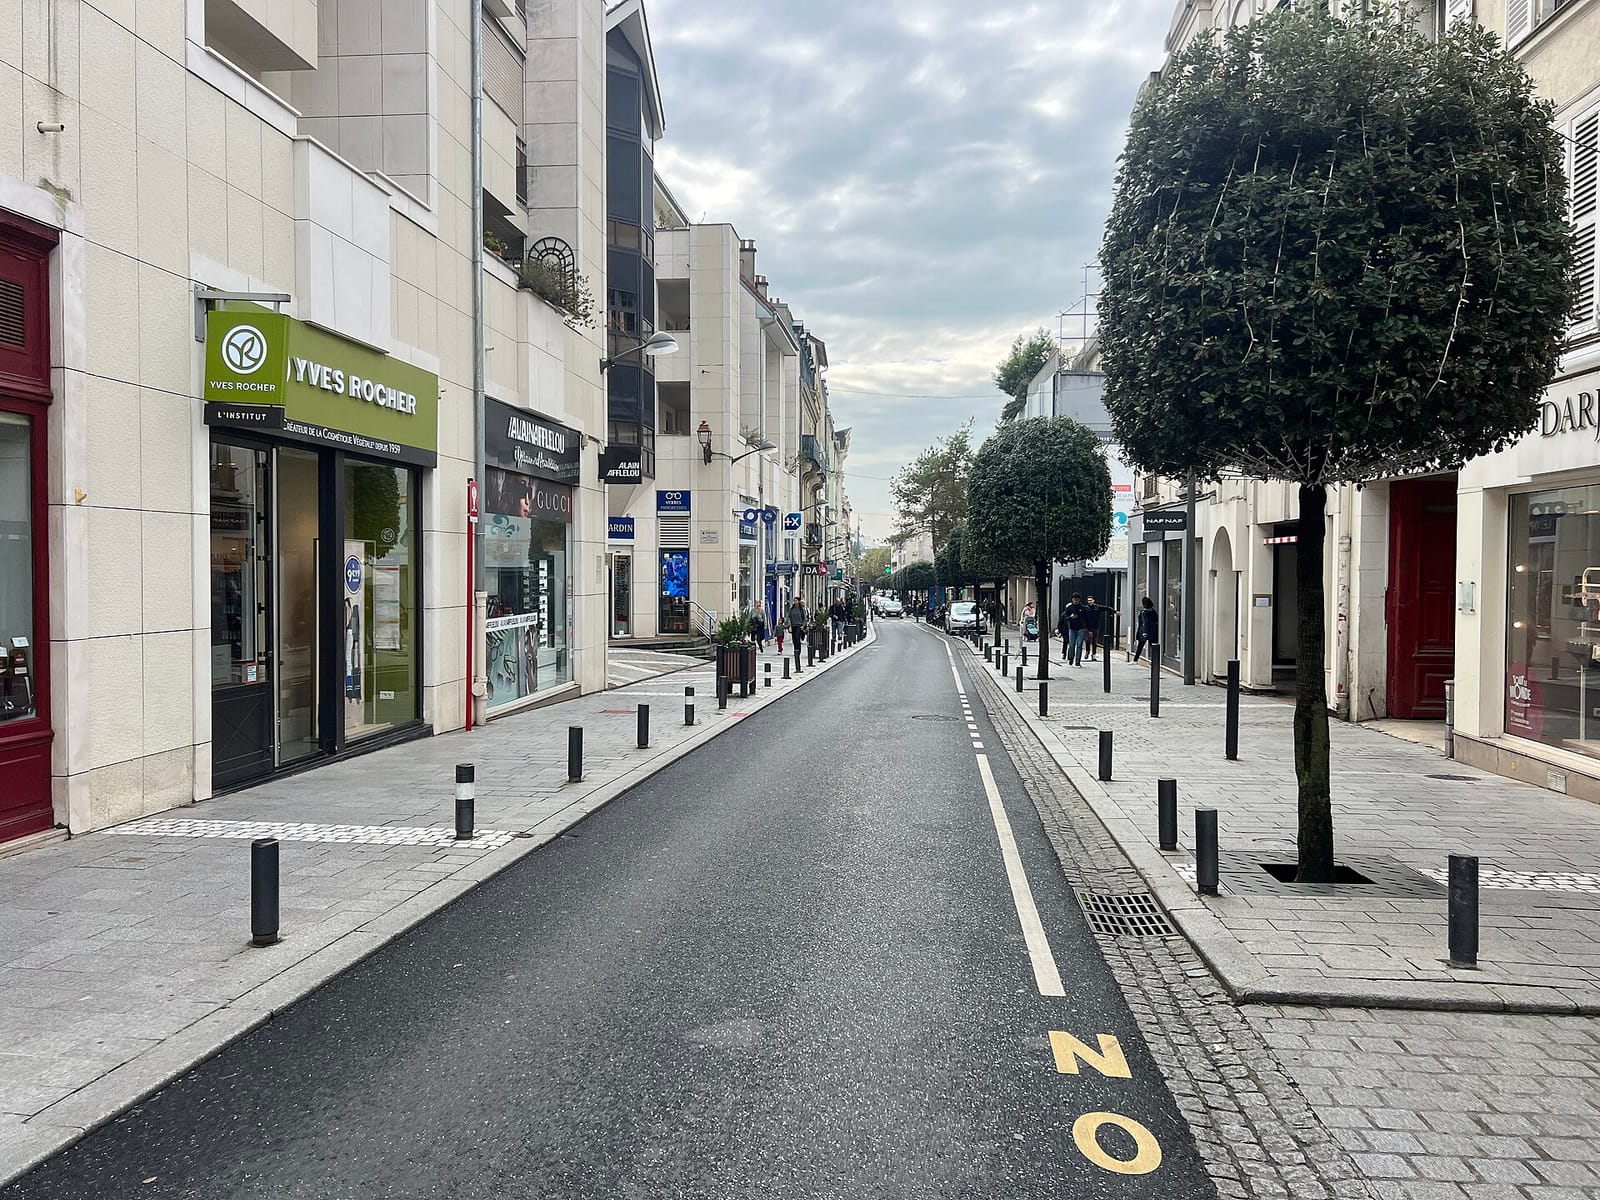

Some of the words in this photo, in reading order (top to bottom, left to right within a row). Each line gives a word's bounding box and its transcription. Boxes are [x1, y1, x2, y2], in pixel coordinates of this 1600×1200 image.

[210, 381, 234, 390] YVES
[236, 382, 276, 392] ROCHER
[293, 357, 345, 394] YVES
[348, 375, 417, 415] ROCHER
[217, 411, 267, 420] L'INSTITUT
[308, 427, 316, 437] DE
[316, 429, 323, 438] LA
[388, 443, 401, 454] 1959
[537, 490, 570, 513] GUCCI
[608, 523, 633, 533] ARDIN
